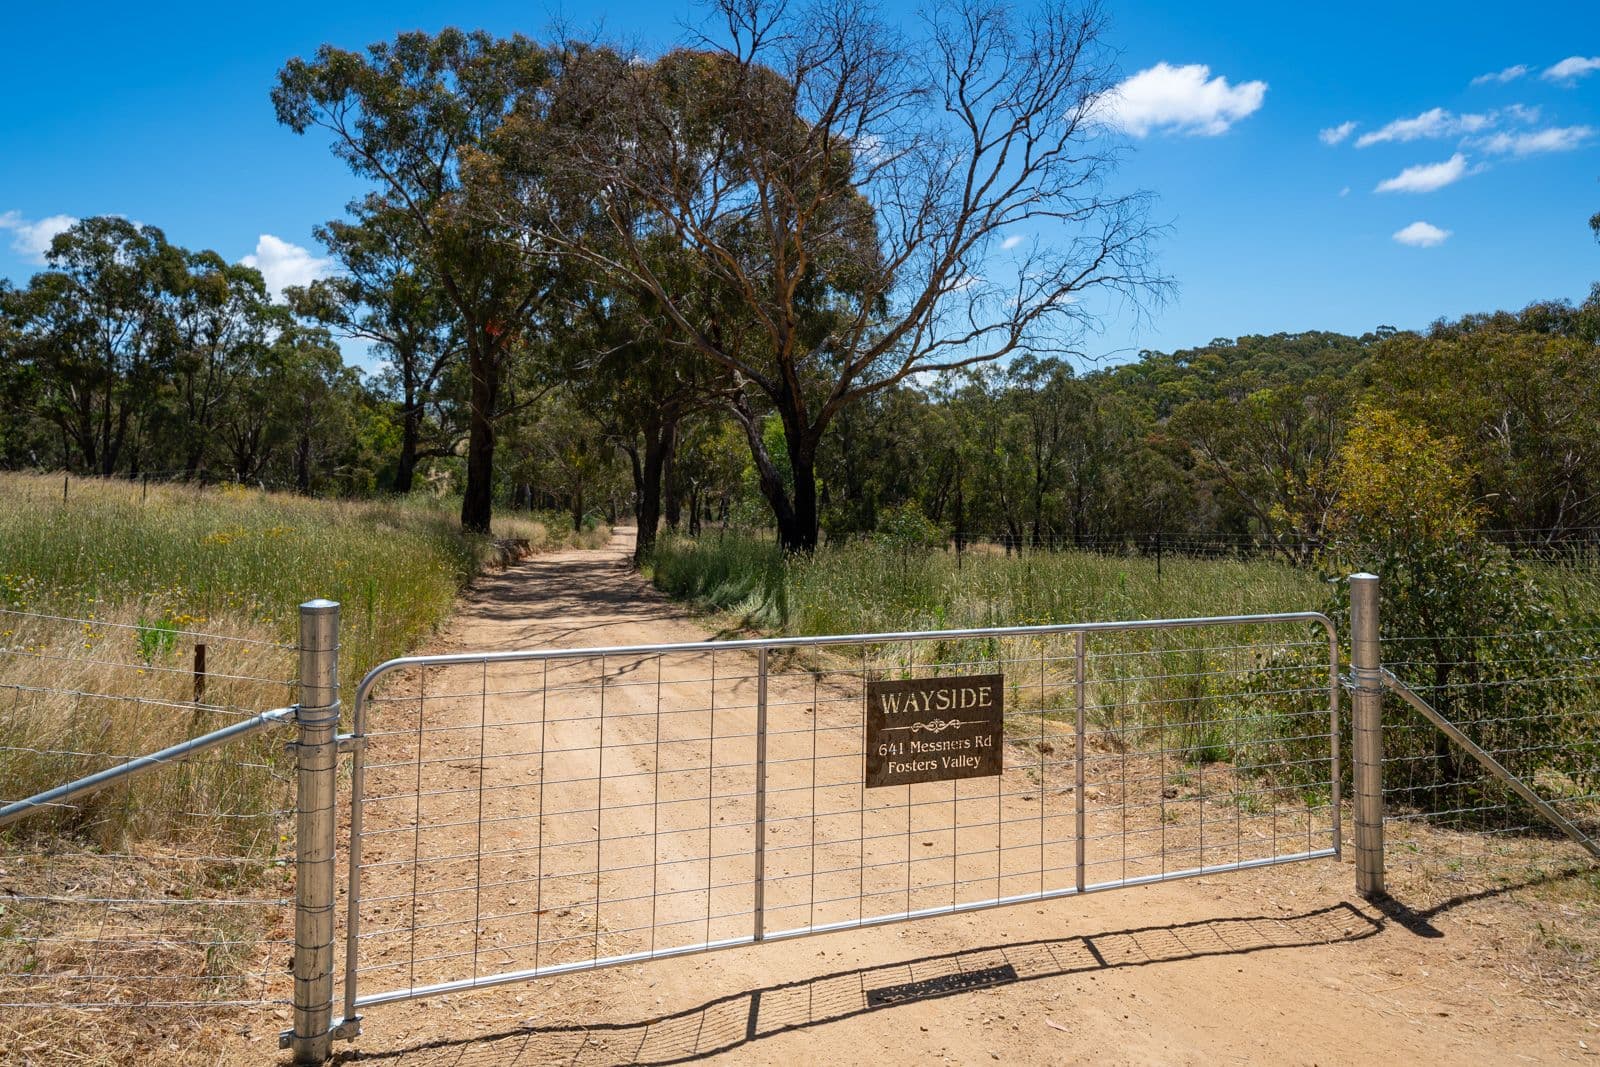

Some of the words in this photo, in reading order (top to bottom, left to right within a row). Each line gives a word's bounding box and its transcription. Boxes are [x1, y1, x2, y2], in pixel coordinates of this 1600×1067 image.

[881, 686, 992, 714] WAYSIDE
[879, 742, 903, 756] 641
[910, 738, 971, 754] Messners
[975, 735, 992, 748] Rd
[888, 760, 938, 774] Fosters
[942, 755, 981, 769] Valley
